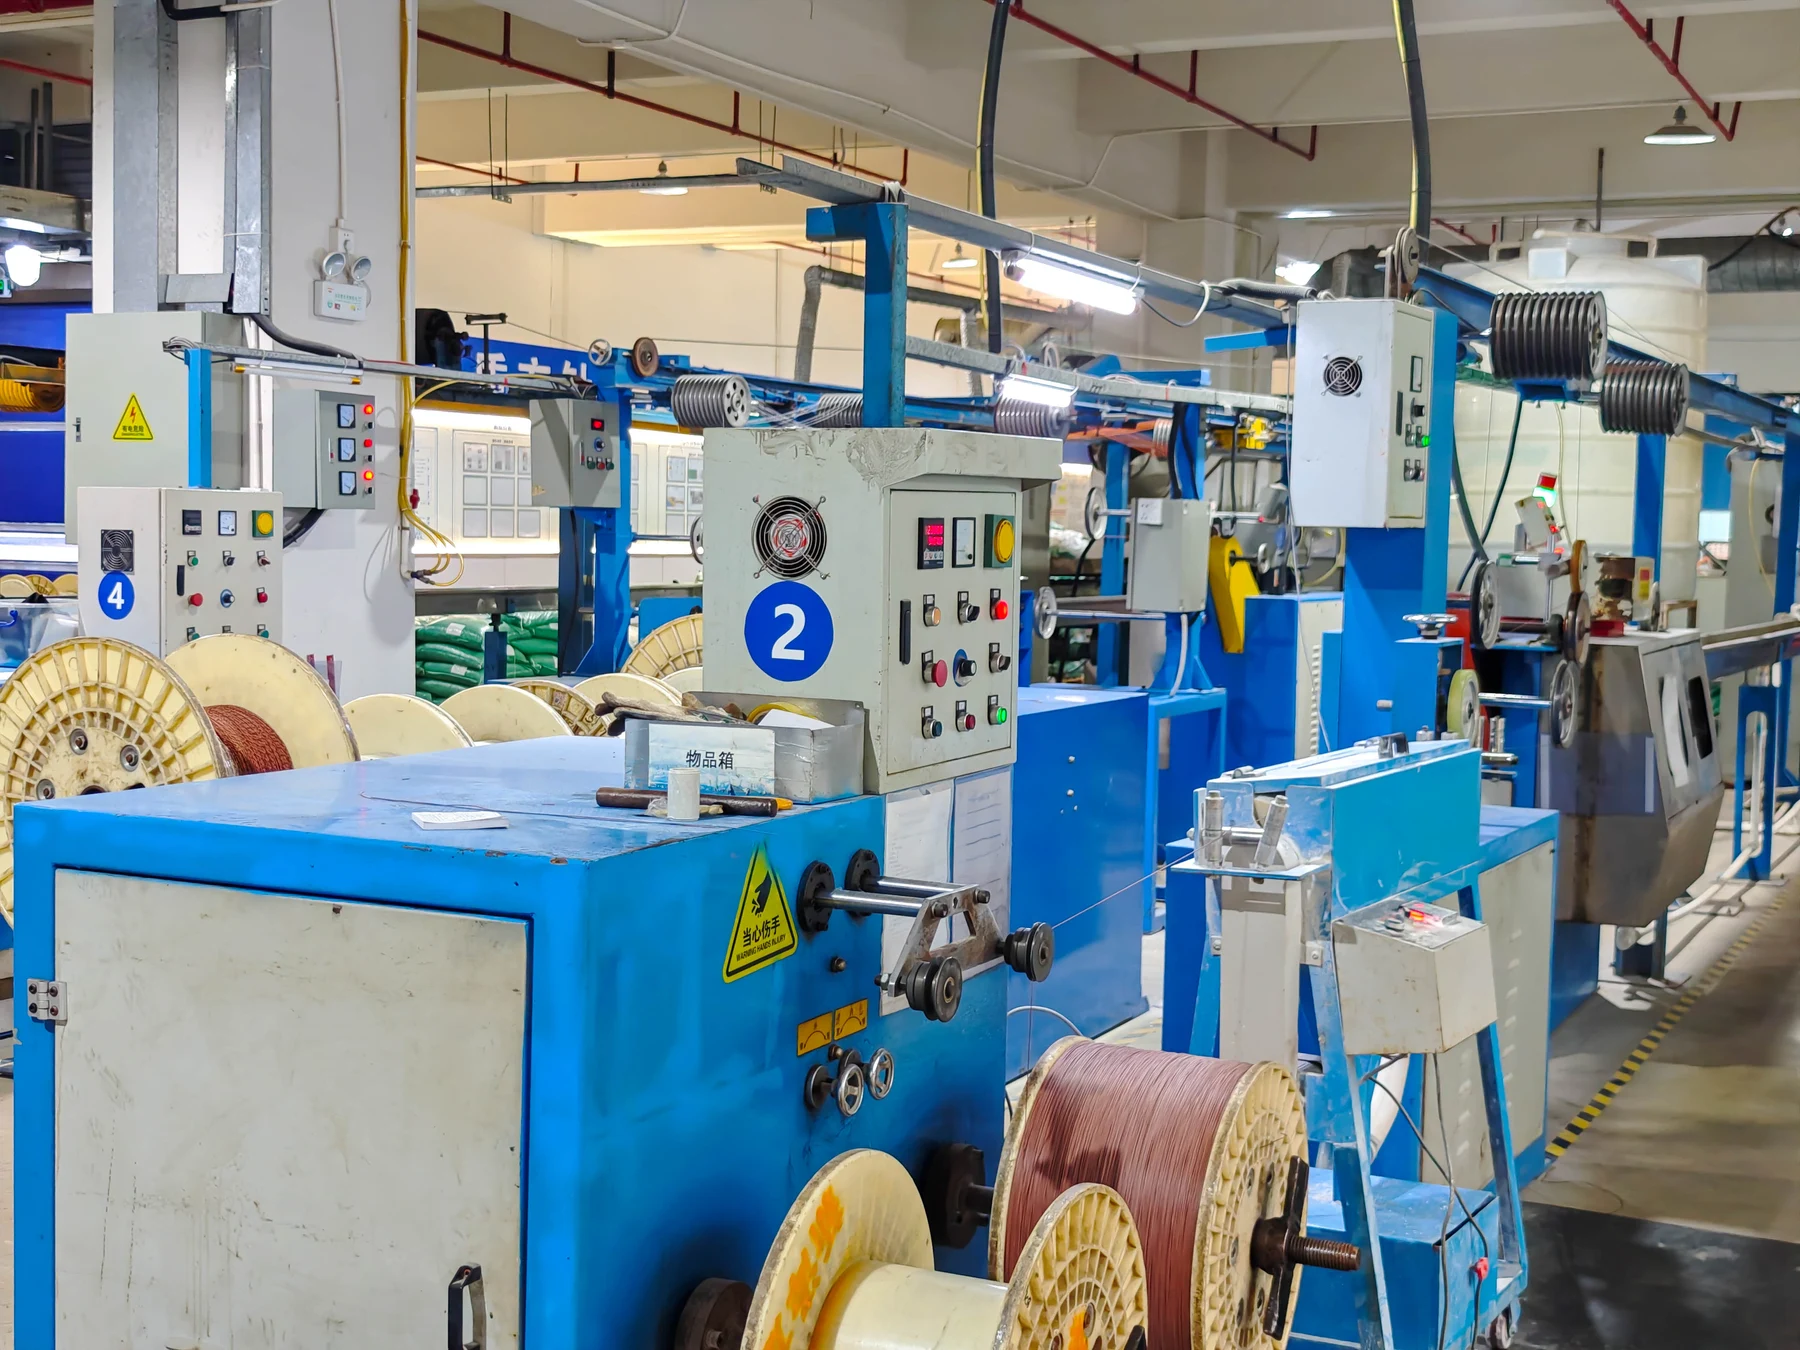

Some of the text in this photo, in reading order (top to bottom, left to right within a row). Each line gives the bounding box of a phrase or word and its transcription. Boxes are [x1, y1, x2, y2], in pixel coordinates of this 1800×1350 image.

[107, 581, 125, 610] 4
[771, 603, 806, 661] 2
[686, 749, 734, 770] 物品箱
[743, 914, 780, 947] 当心伤手
[736, 934, 786, 961] WARNING HANDS INJURY
